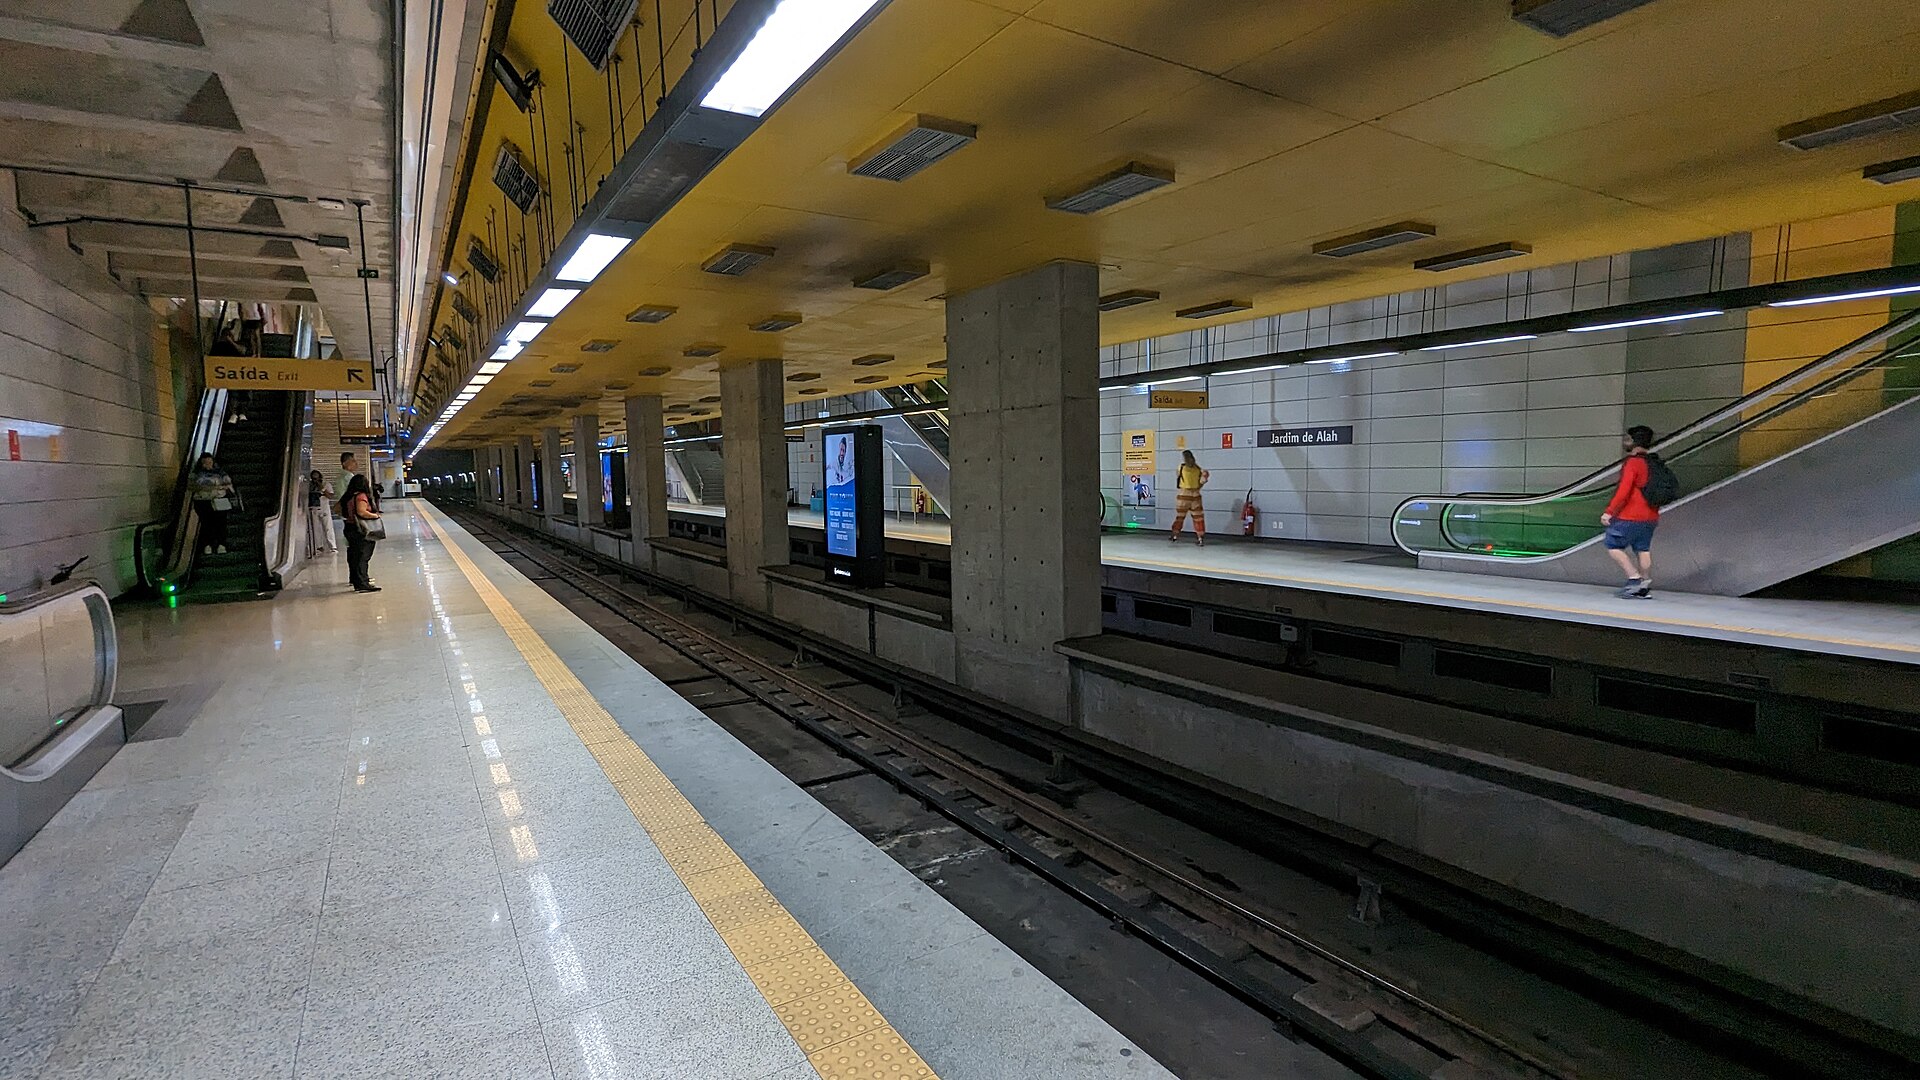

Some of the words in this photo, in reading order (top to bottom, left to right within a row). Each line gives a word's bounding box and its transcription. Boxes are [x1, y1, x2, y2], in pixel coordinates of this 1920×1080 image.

[214, 366, 269, 380] Saída
[277, 371, 299, 381] Exit
[1270, 431, 1299, 444] Jardim
[1302, 431, 1313, 443] de
[1316, 429, 1338, 442] Alah
